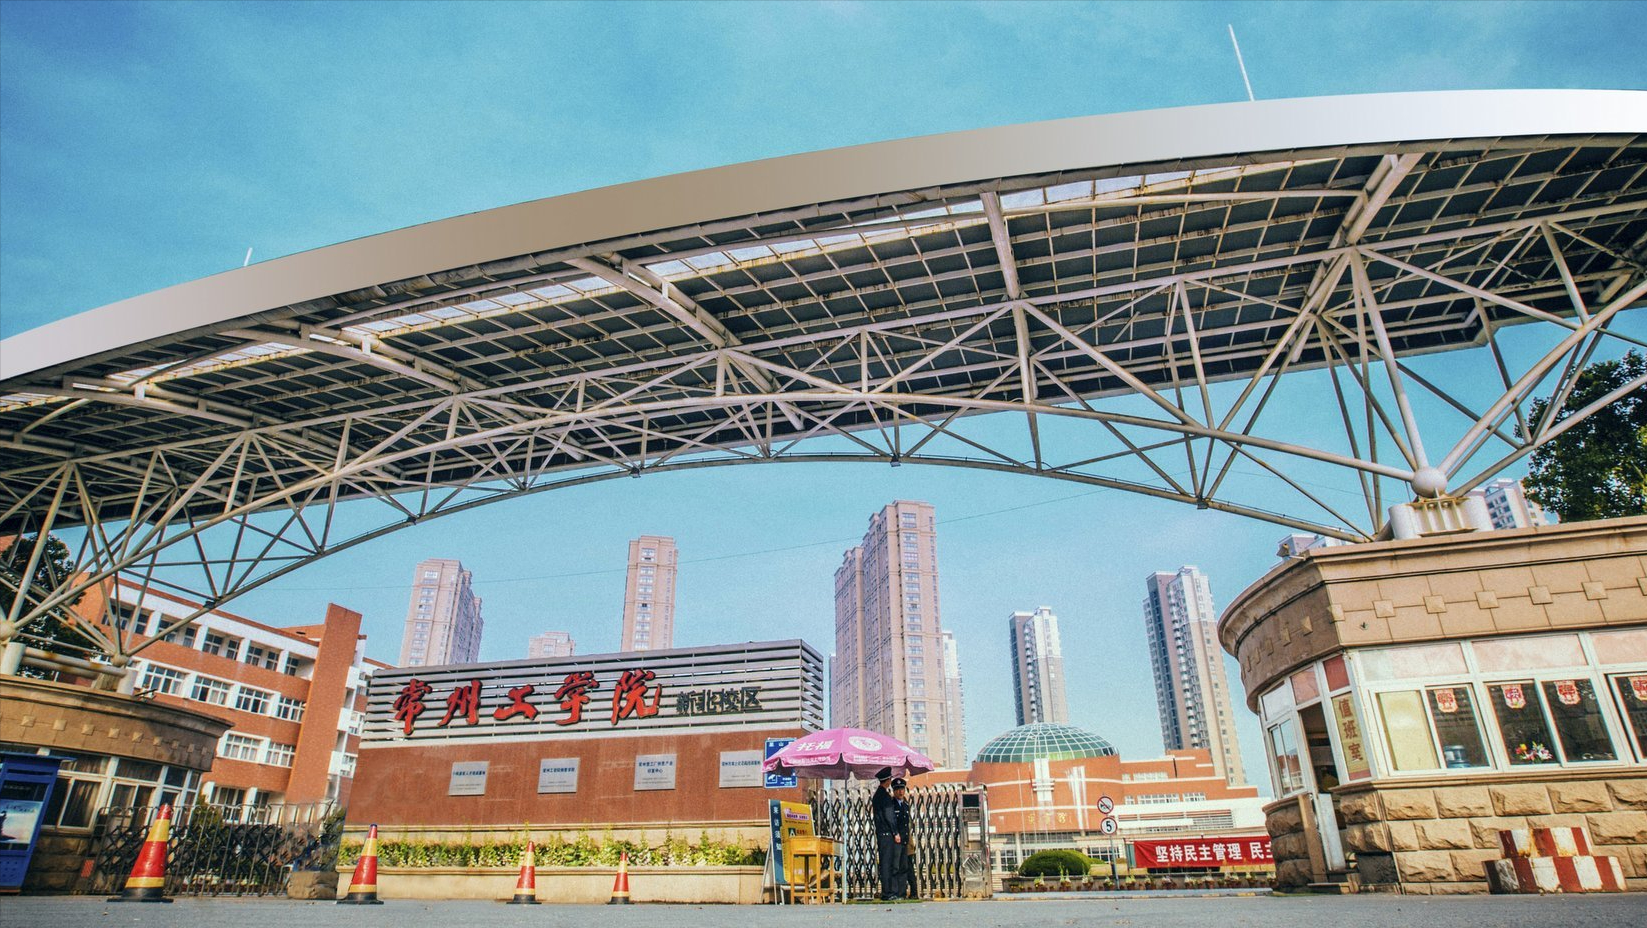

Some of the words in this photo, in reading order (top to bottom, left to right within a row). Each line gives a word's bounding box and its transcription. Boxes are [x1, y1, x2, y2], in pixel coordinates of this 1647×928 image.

[393, 669, 662, 735] 常州工学院
[676, 686, 763, 714] 新北校区
[1339, 698, 1363, 760] 值班室
[1106, 821, 1112, 832] 5
[1155, 843, 1243, 863] 坚持民主管理
